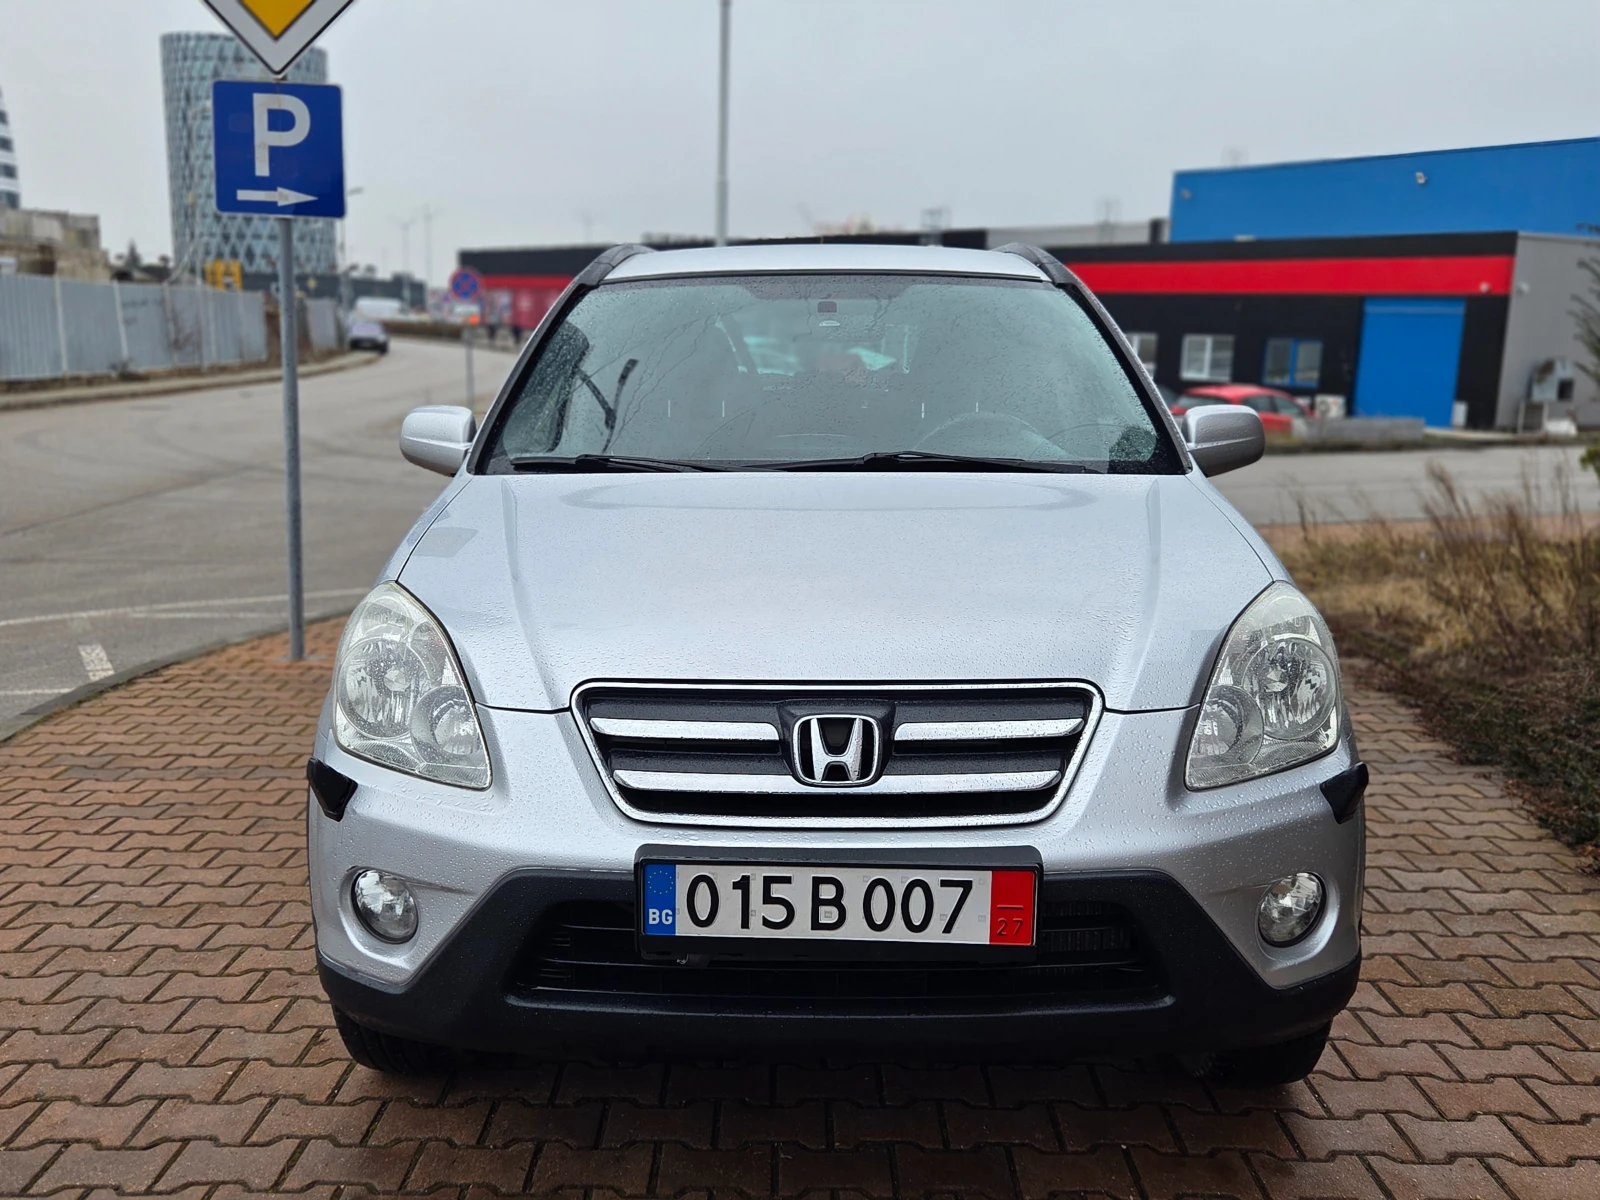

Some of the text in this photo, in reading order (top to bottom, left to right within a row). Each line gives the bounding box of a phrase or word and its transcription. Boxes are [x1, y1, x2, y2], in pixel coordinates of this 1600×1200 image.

[252, 93, 311, 178] P
[648, 908, 673, 925] BG
[996, 917, 1024, 937] 27
